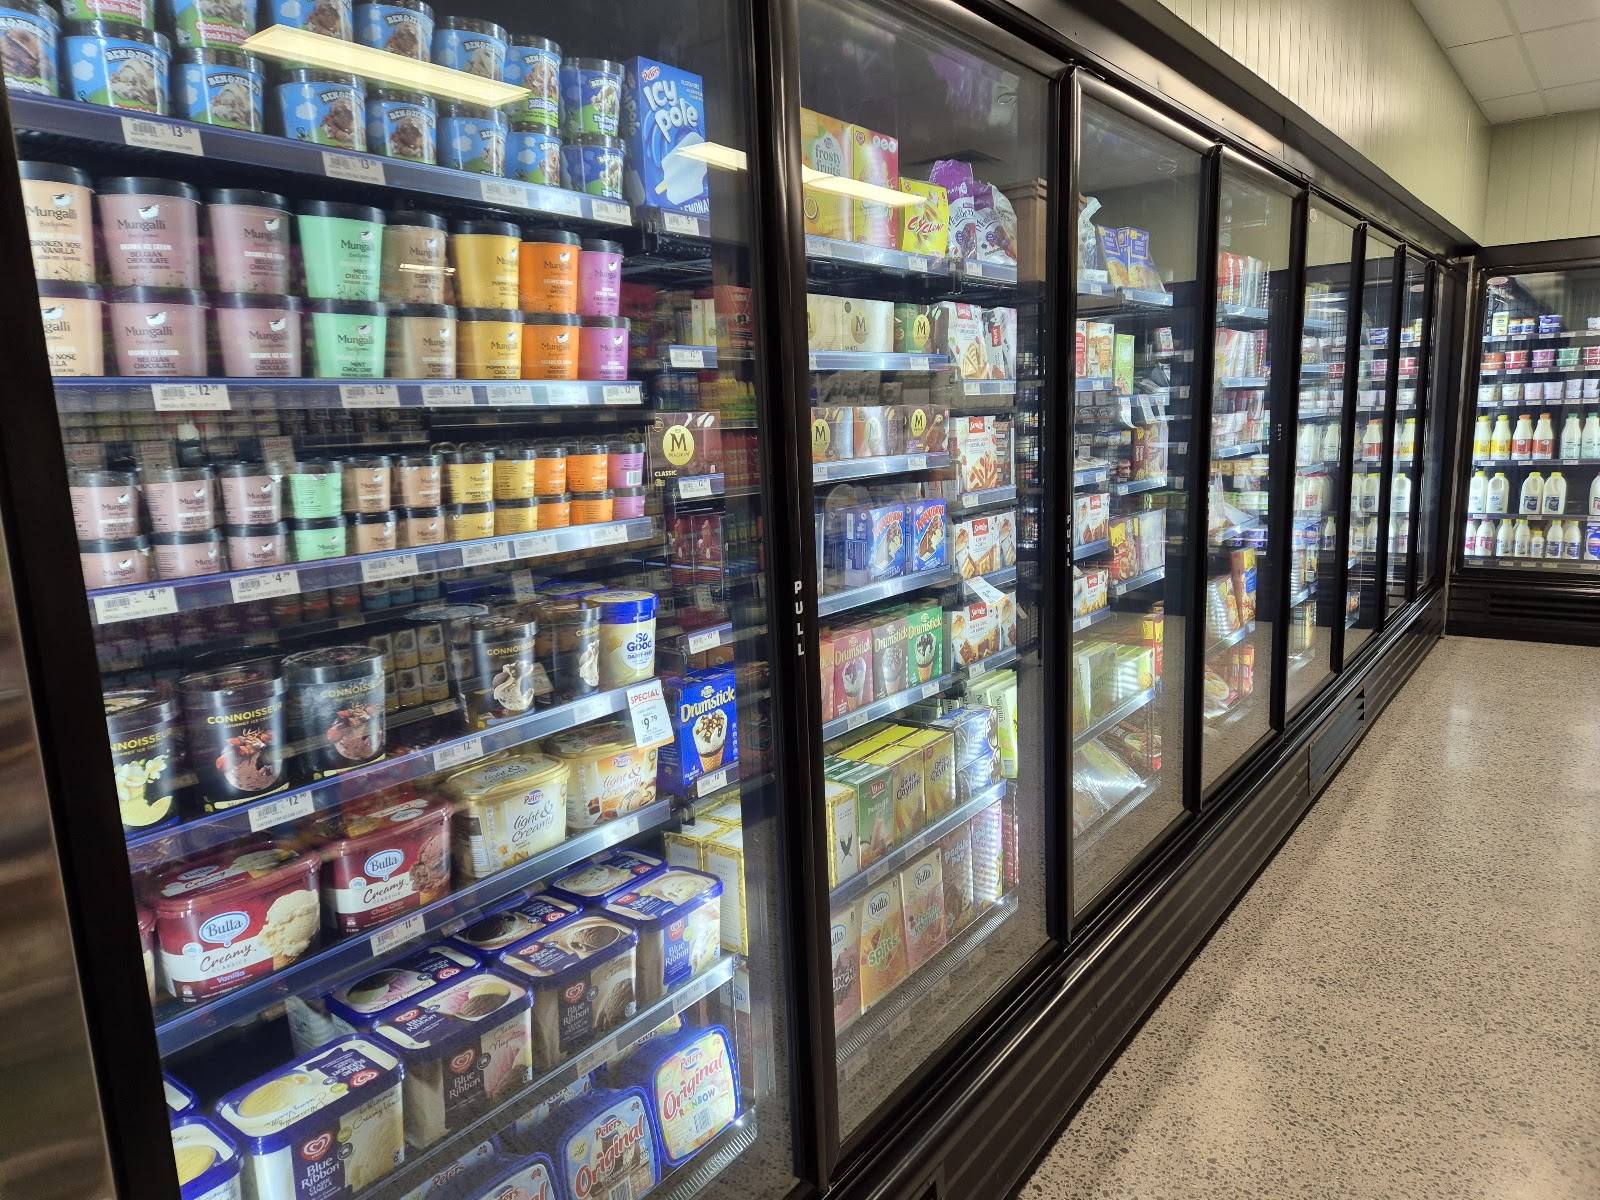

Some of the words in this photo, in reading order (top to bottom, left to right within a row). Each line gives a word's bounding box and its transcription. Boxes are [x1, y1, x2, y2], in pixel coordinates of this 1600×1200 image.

[655, 97, 699, 143] pole
[815, 145, 842, 165] frosty
[27, 205, 77, 220] Mungalli
[117, 219, 165, 231] Mungalli
[42, 247, 75, 255] VANILLA
[44, 321, 70, 333] galli
[125, 326, 173, 338] Mungalli
[917, 321, 927, 335] M
[915, 415, 923, 427] M
[671, 433, 687, 452] M
[815, 431, 826, 442] M
[794, 580, 805, 656] PULL
[908, 615, 942, 638] Drumstick
[874, 624, 909, 653] Drumstick
[834, 639, 872, 664] Drumstick
[631, 689, 660, 704] SPECIAL
[680, 686, 735, 723] Drumstick
[207, 702, 282, 725] CONNOISSEUR
[612, 755, 632, 767] Peters
[603, 773, 628, 788] light
[628, 764, 642, 779] &
[524, 791, 544, 805] Peters
[514, 811, 540, 829] light
[539, 801, 553, 818] &
[512, 815, 554, 843] Creamy
[370, 856, 399, 872] Bulla
[363, 879, 404, 904] Creamy
[869, 897, 889, 914] Bulla
[205, 919, 242, 936] Bulla
[668, 940, 686, 954] Blue
[831, 930, 844, 947] ulla
[200, 943, 252, 972] Creamy
[665, 946, 689, 967] Ribbon
[867, 935, 898, 967] splits
[211, 958, 247, 973] CLASSICS
[216, 971, 245, 984] Vanilla
[563, 1007, 589, 1026] Ribbon
[567, 1002, 585, 1015] Blue
[680, 1051, 703, 1071] Peters
[448, 1076, 482, 1099] Ribbon
[453, 1069, 475, 1086] Blue
[663, 1049, 724, 1121] Original
[679, 1088, 716, 1118] RAINBOW
[595, 1118, 622, 1141] Peters
[306, 1156, 334, 1176] Blue
[575, 1113, 645, 1199] Original
[301, 1162, 341, 1190] Ribbon
